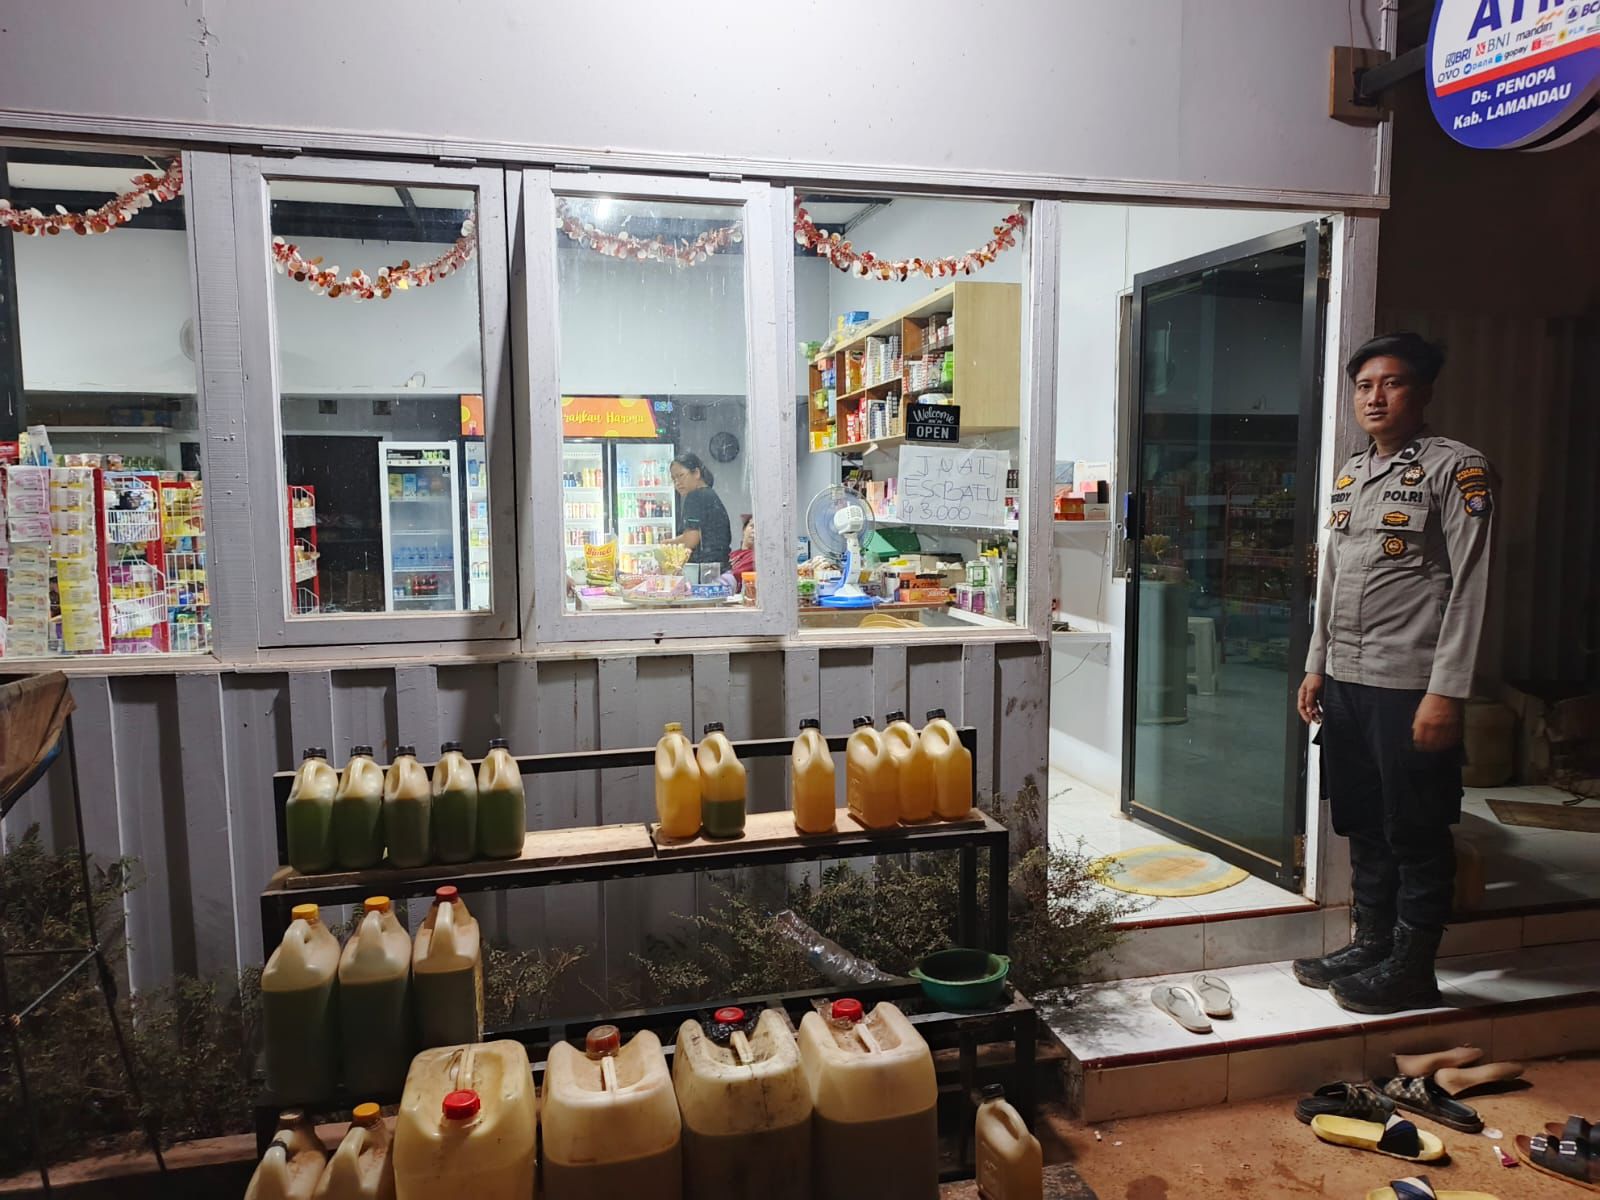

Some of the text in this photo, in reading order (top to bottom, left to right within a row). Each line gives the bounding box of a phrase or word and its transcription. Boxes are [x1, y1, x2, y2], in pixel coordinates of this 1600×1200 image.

[1487, 32, 1510, 52] BNI
[1437, 68, 1460, 83] OVO
[1504, 45, 1528, 60] gopay
[1471, 66, 1556, 105] Ds. PENOPA
[1453, 82, 1572, 130] Kab. LAMANDAU
[912, 406, 955, 424] Welcome
[916, 425, 950, 439] OPEN
[1382, 490, 1423, 503] POLRI
